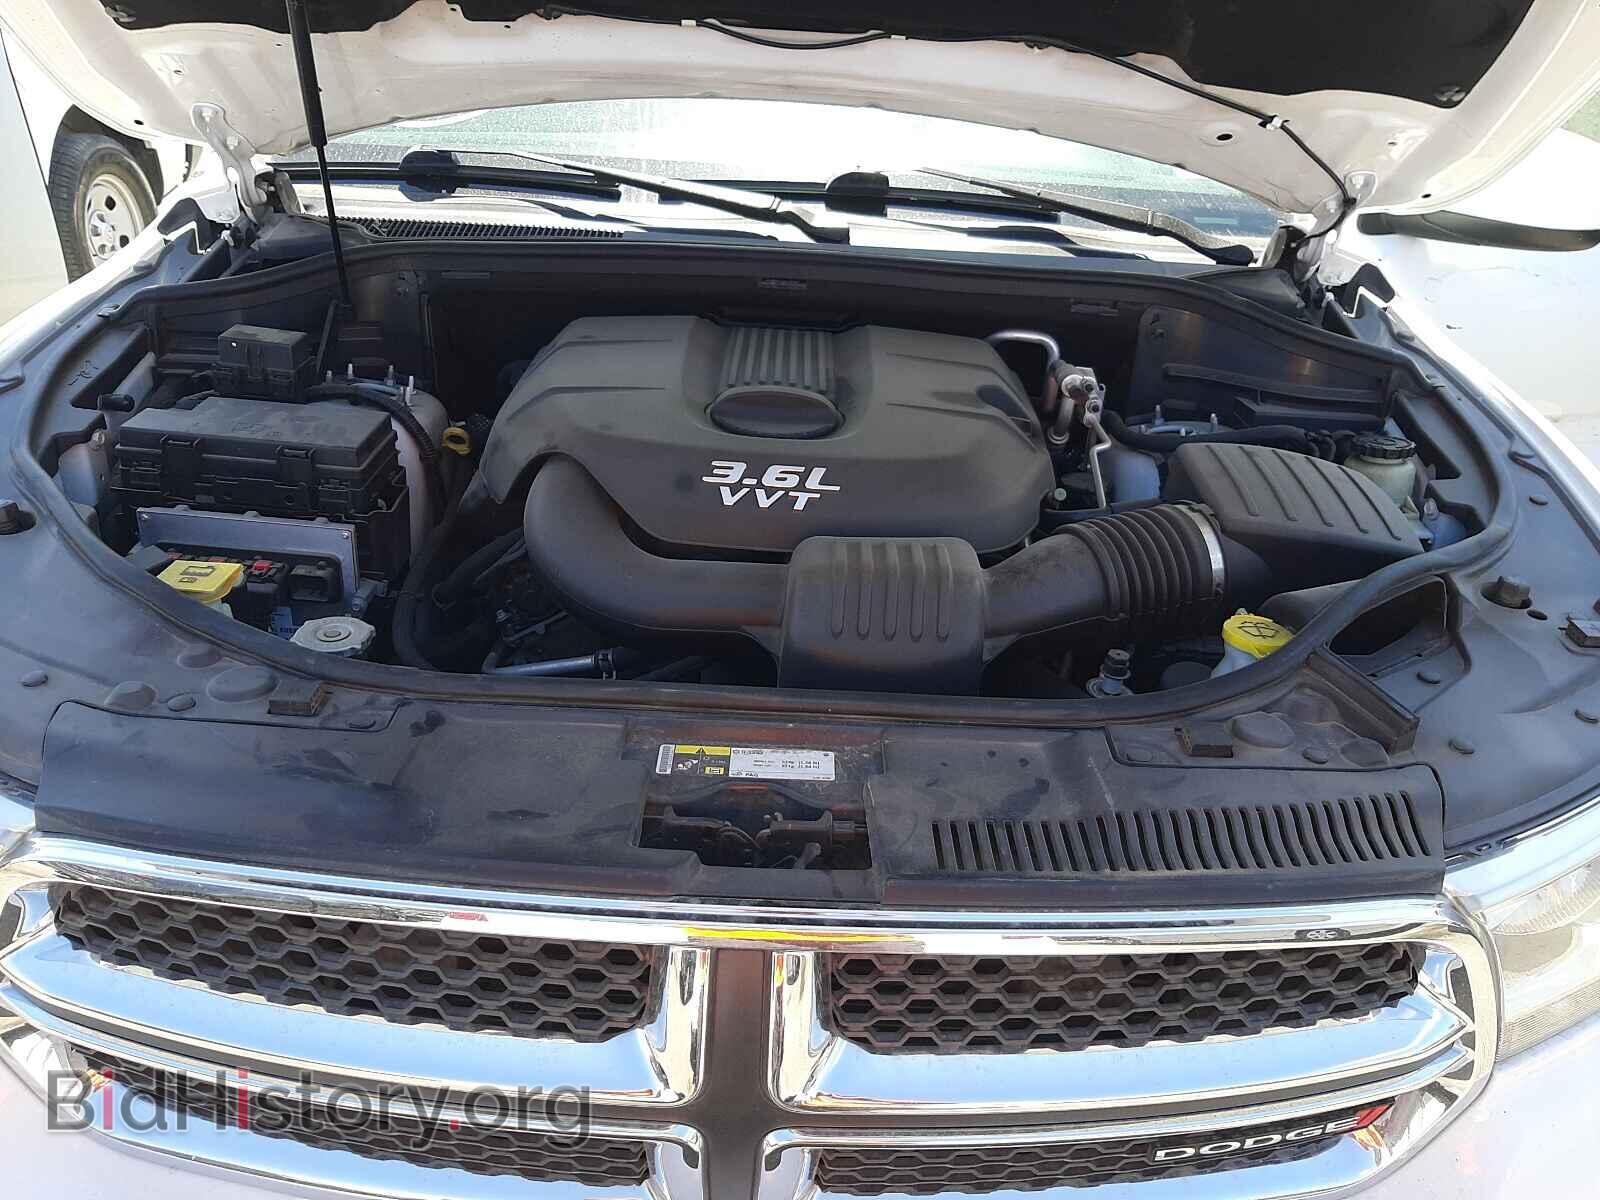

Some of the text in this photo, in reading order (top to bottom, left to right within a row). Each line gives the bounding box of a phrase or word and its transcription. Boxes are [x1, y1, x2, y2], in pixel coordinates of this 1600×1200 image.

[702, 460, 841, 491] 3.6L
[719, 486, 821, 511] VVT
[1154, 1116, 1361, 1161] DODGE
